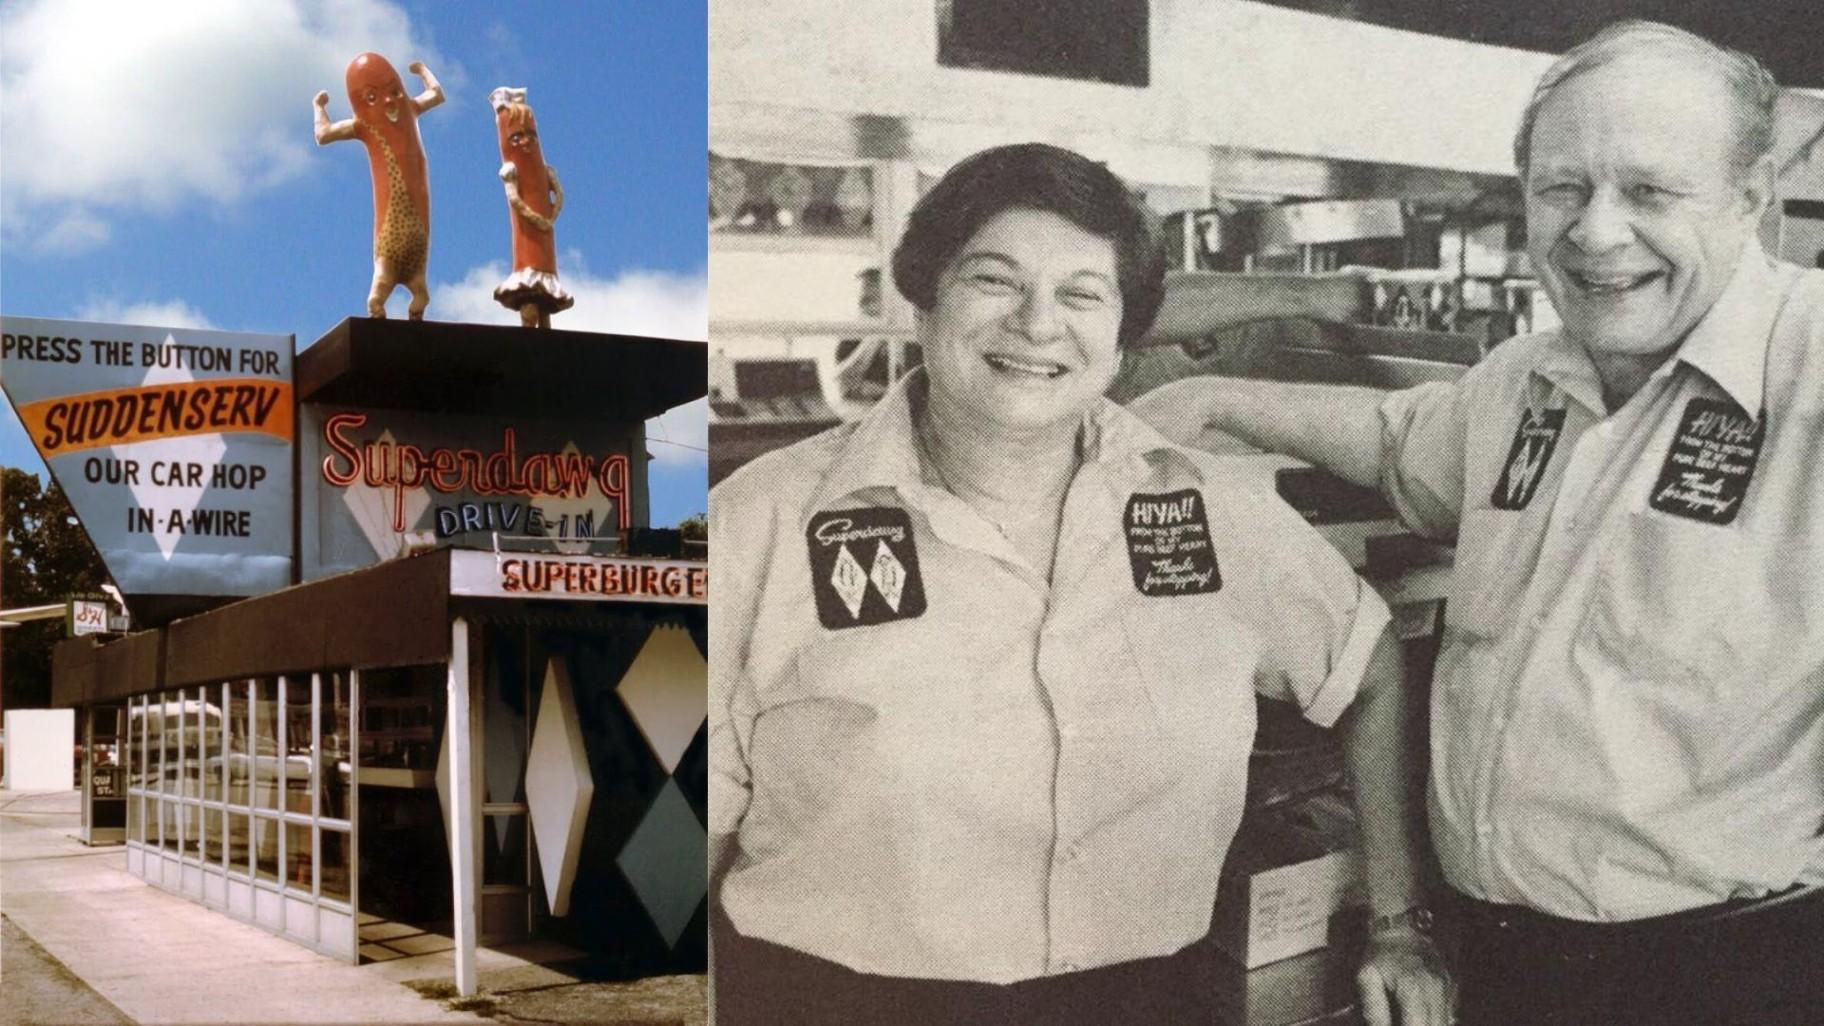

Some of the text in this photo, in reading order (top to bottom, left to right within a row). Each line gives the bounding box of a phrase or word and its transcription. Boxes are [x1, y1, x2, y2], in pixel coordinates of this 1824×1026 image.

[2, 334, 281, 375] PRESS THE BUTTON FOR
[43, 384, 280, 451] SUDDENSERV
[84, 457, 267, 490] OUR CAR HOP
[323, 414, 632, 534] Superdawg
[435, 503, 597, 543] DRIVE-IN
[1133, 496, 1195, 524] HIYA!!
[502, 558, 708, 598] SUPERBURGE
